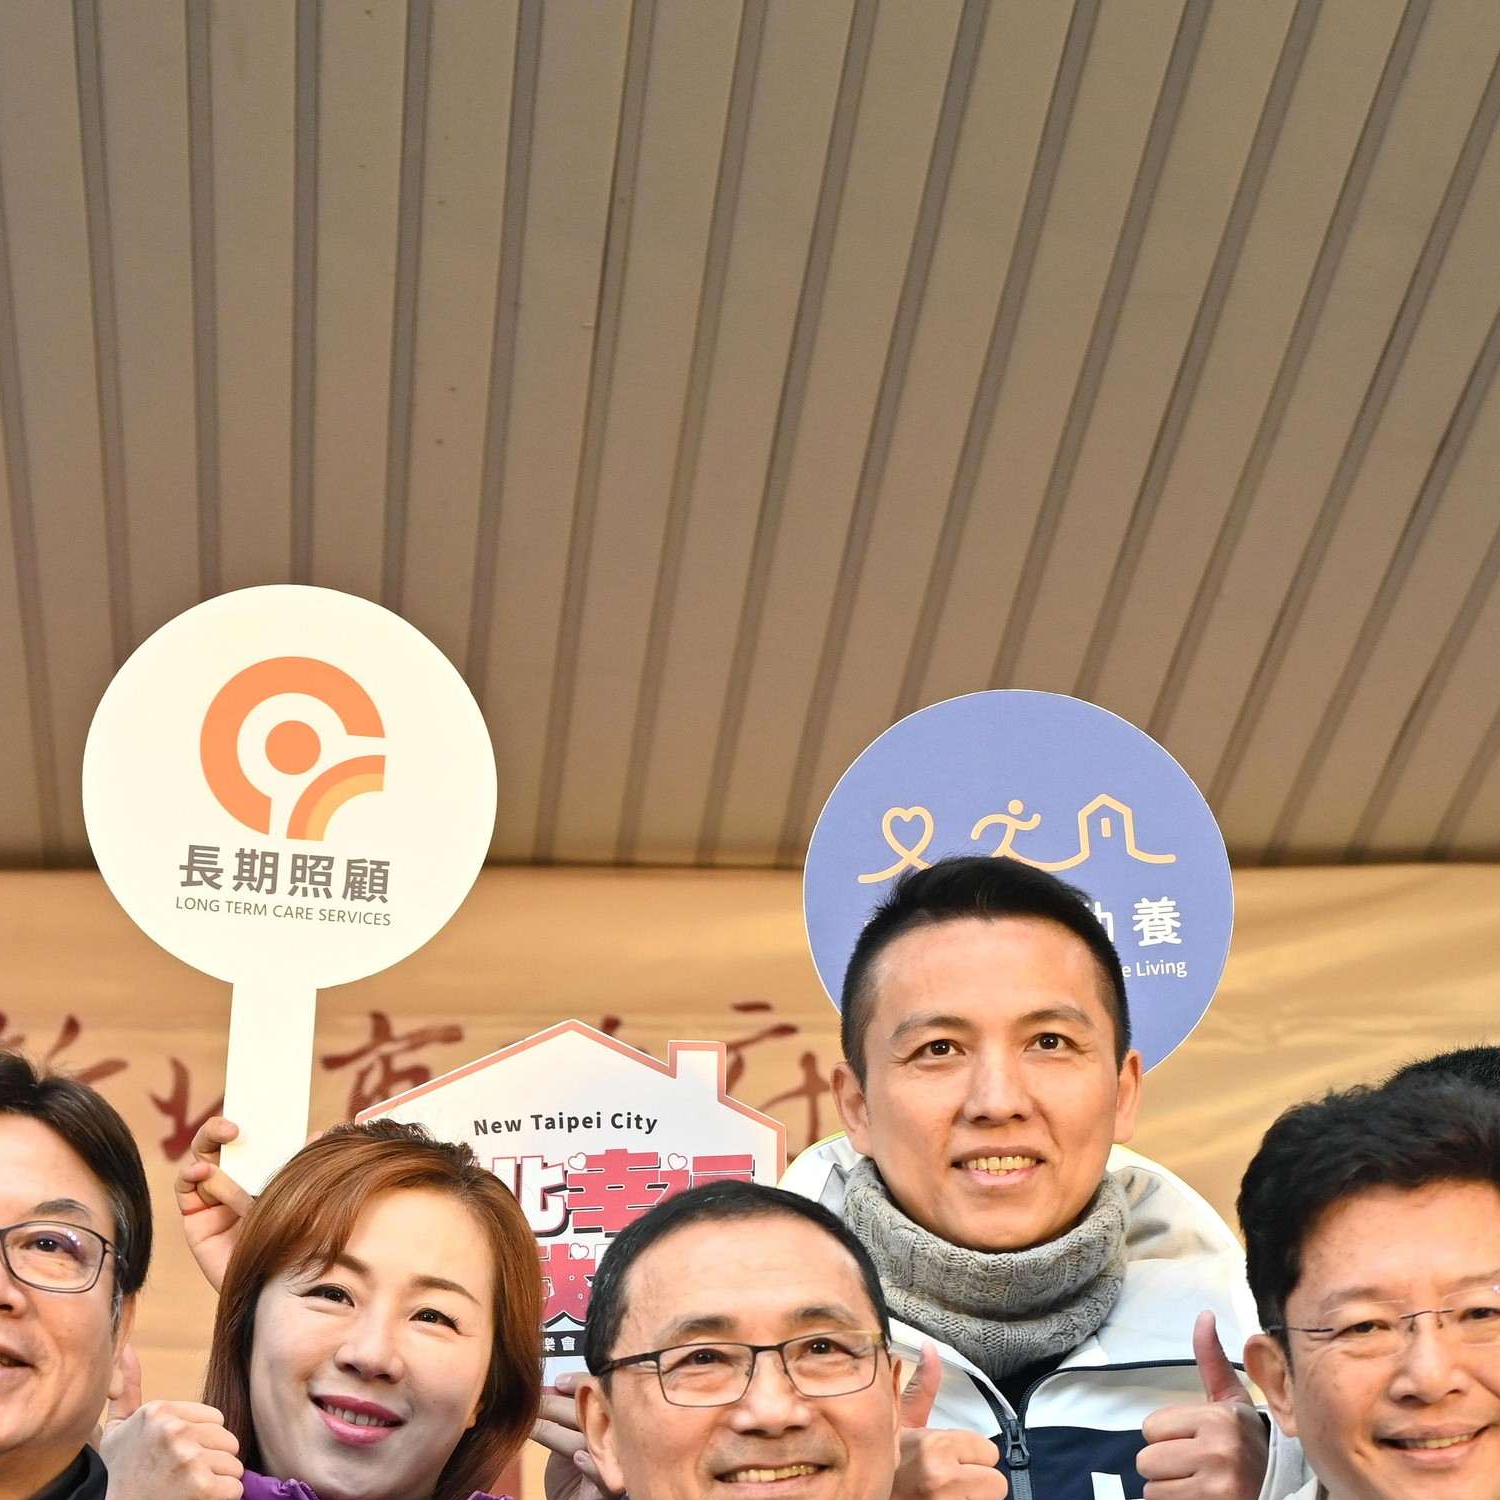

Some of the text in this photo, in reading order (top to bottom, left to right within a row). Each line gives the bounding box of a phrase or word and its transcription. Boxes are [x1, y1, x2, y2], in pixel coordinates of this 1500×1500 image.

[178, 843, 392, 904] 長期照顧
[175, 896, 392, 927] LONG TERM CARE SERVICES
[1136, 960, 1188, 978] Living
[473, 1111, 658, 1136] New Taipei City
